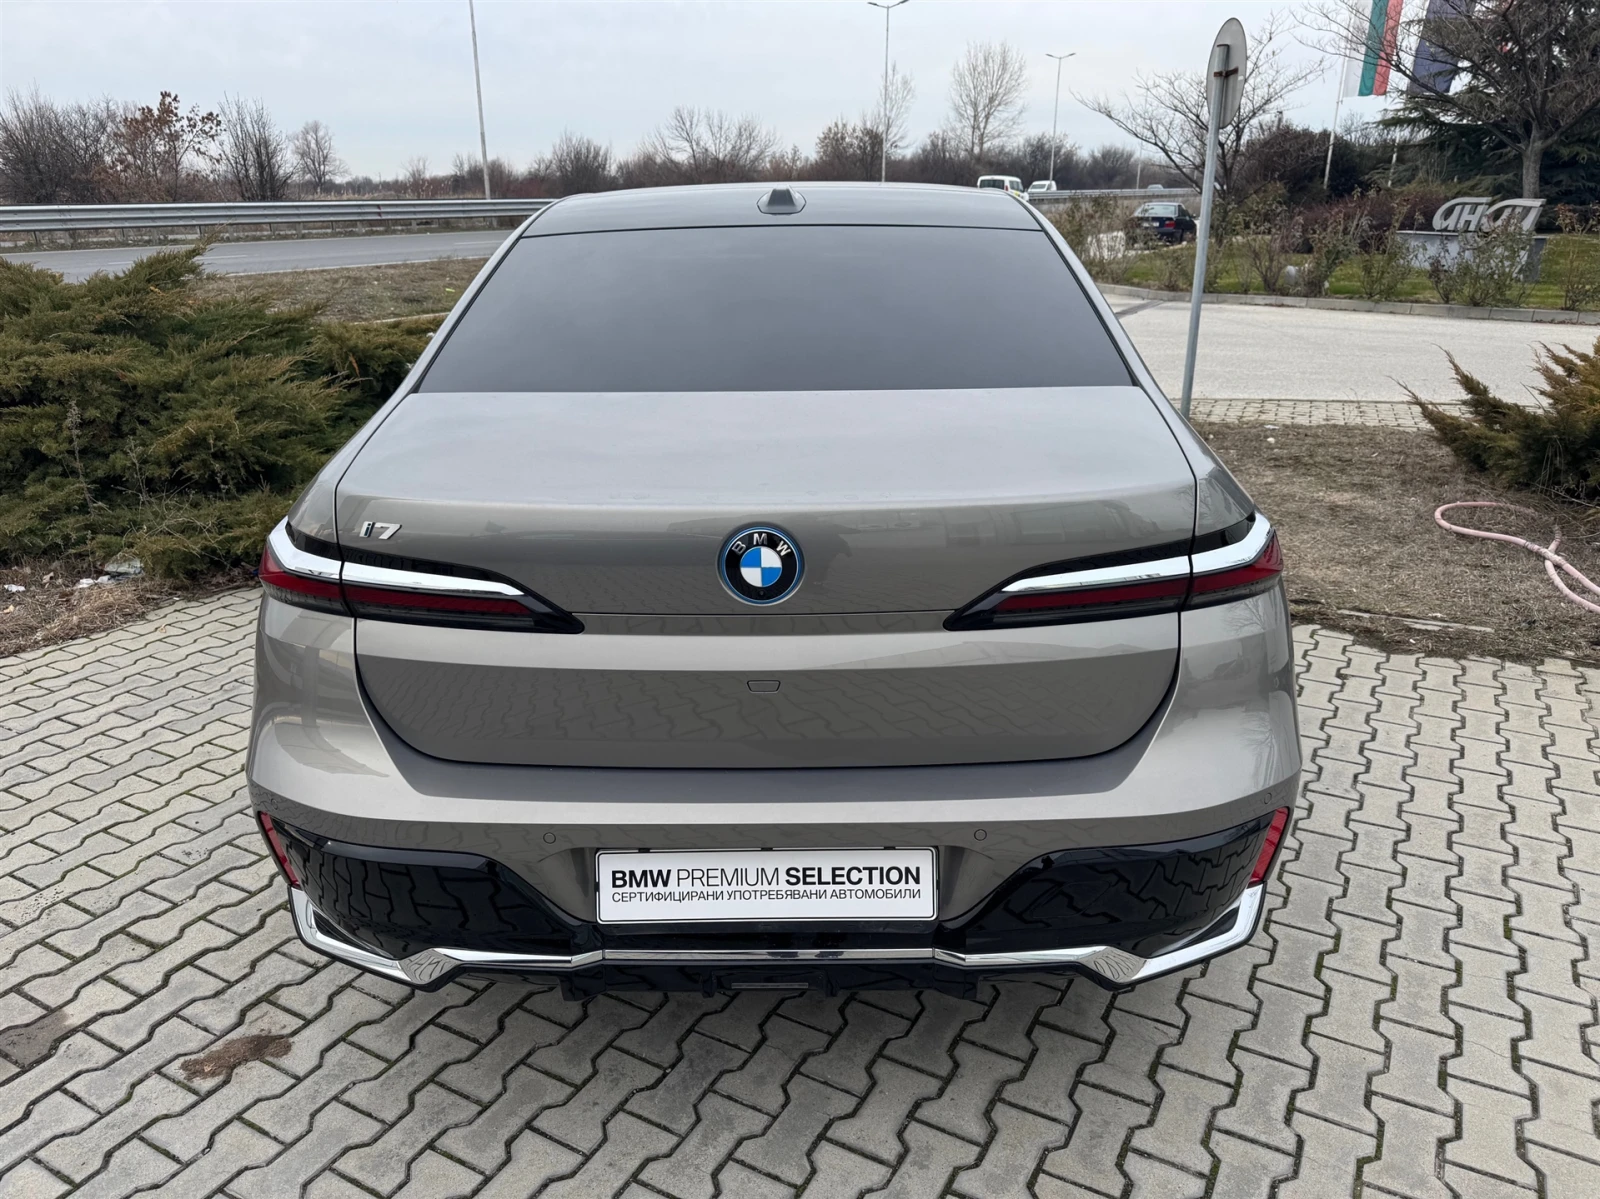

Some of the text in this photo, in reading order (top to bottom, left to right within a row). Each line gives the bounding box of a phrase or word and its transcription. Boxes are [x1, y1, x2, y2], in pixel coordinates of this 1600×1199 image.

[359, 521, 402, 540] i7
[731, 533, 791, 556] BMW
[611, 866, 921, 889] BMW PREMIUM SELECTION
[611, 888, 921, 903] СЕРТИФИЦИРАНИ УПОТРЕБЯВАНИ АВТОМОБИЛИ
